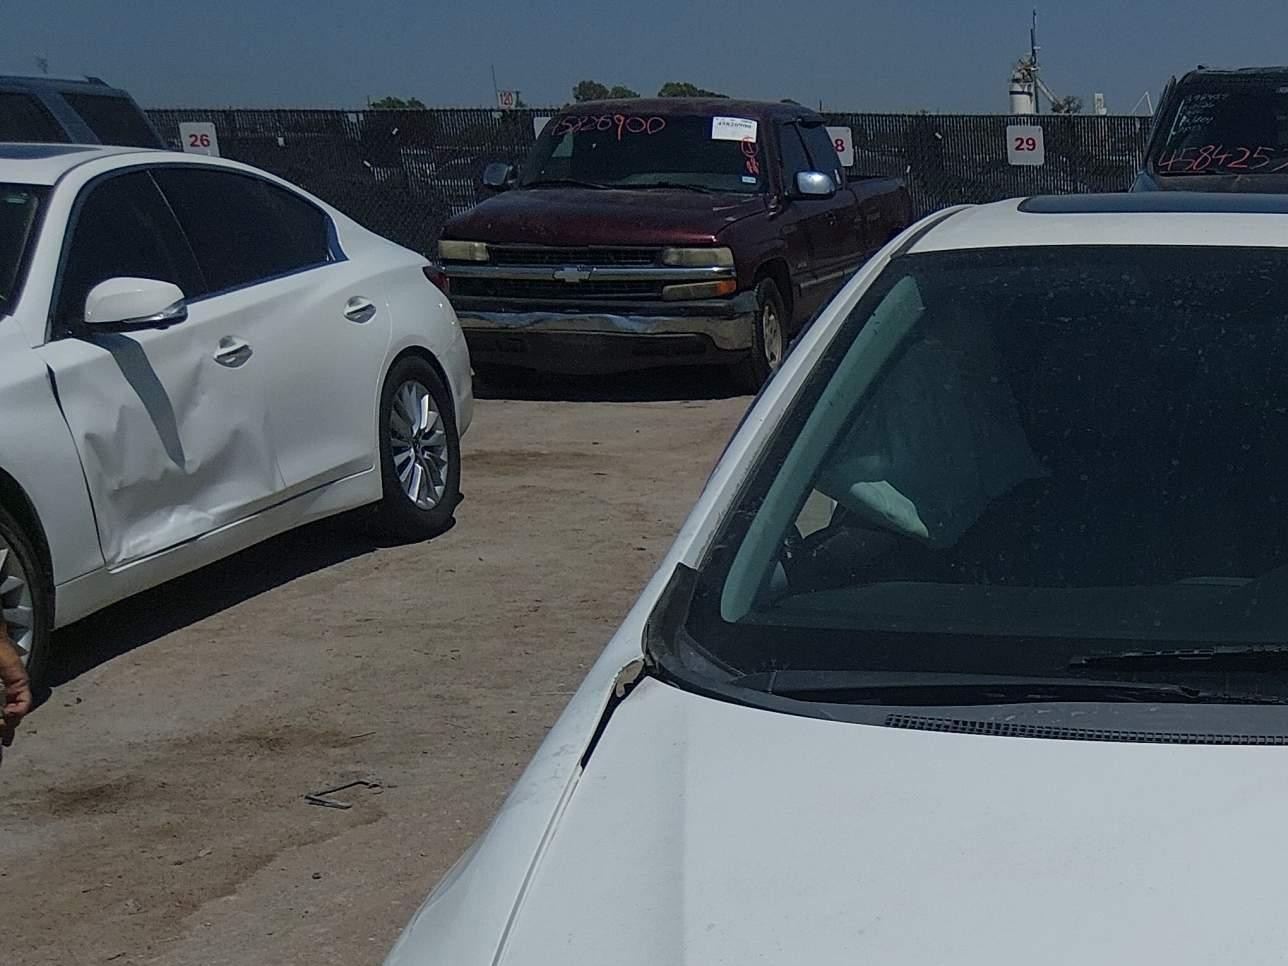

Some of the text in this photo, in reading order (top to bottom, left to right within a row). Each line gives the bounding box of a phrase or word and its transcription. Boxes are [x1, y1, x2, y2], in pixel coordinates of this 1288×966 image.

[189, 134, 210, 147] 26
[834, 138, 846, 153] 8
[1014, 137, 1037, 151] 29
